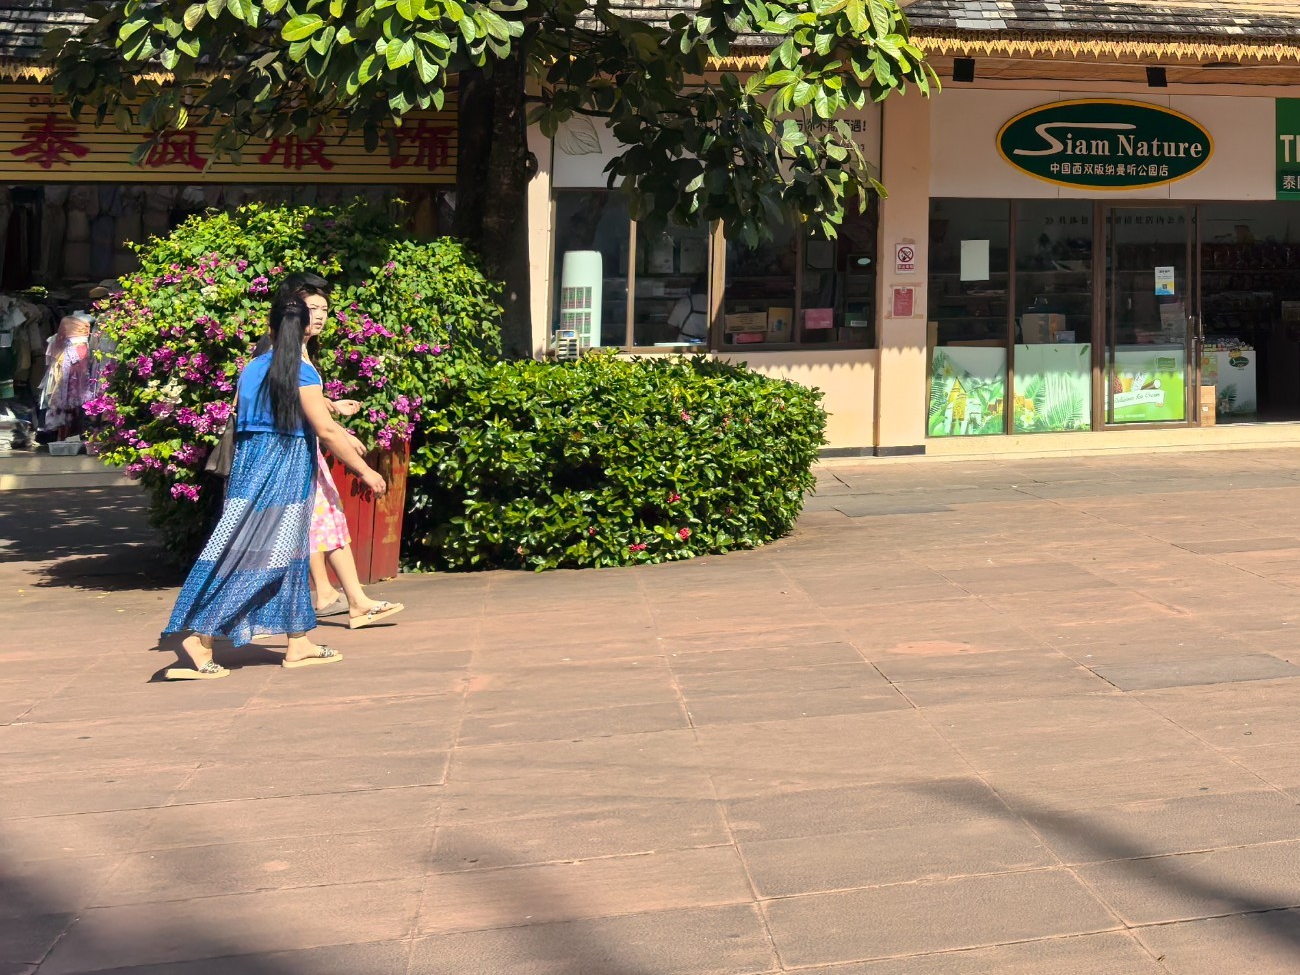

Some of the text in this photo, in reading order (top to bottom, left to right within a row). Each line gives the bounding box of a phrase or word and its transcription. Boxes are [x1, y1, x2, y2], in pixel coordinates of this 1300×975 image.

[1013, 122, 1202, 158] Siam Nature
[1050, 162, 1169, 177] 中国西双版纳曼听公园店
